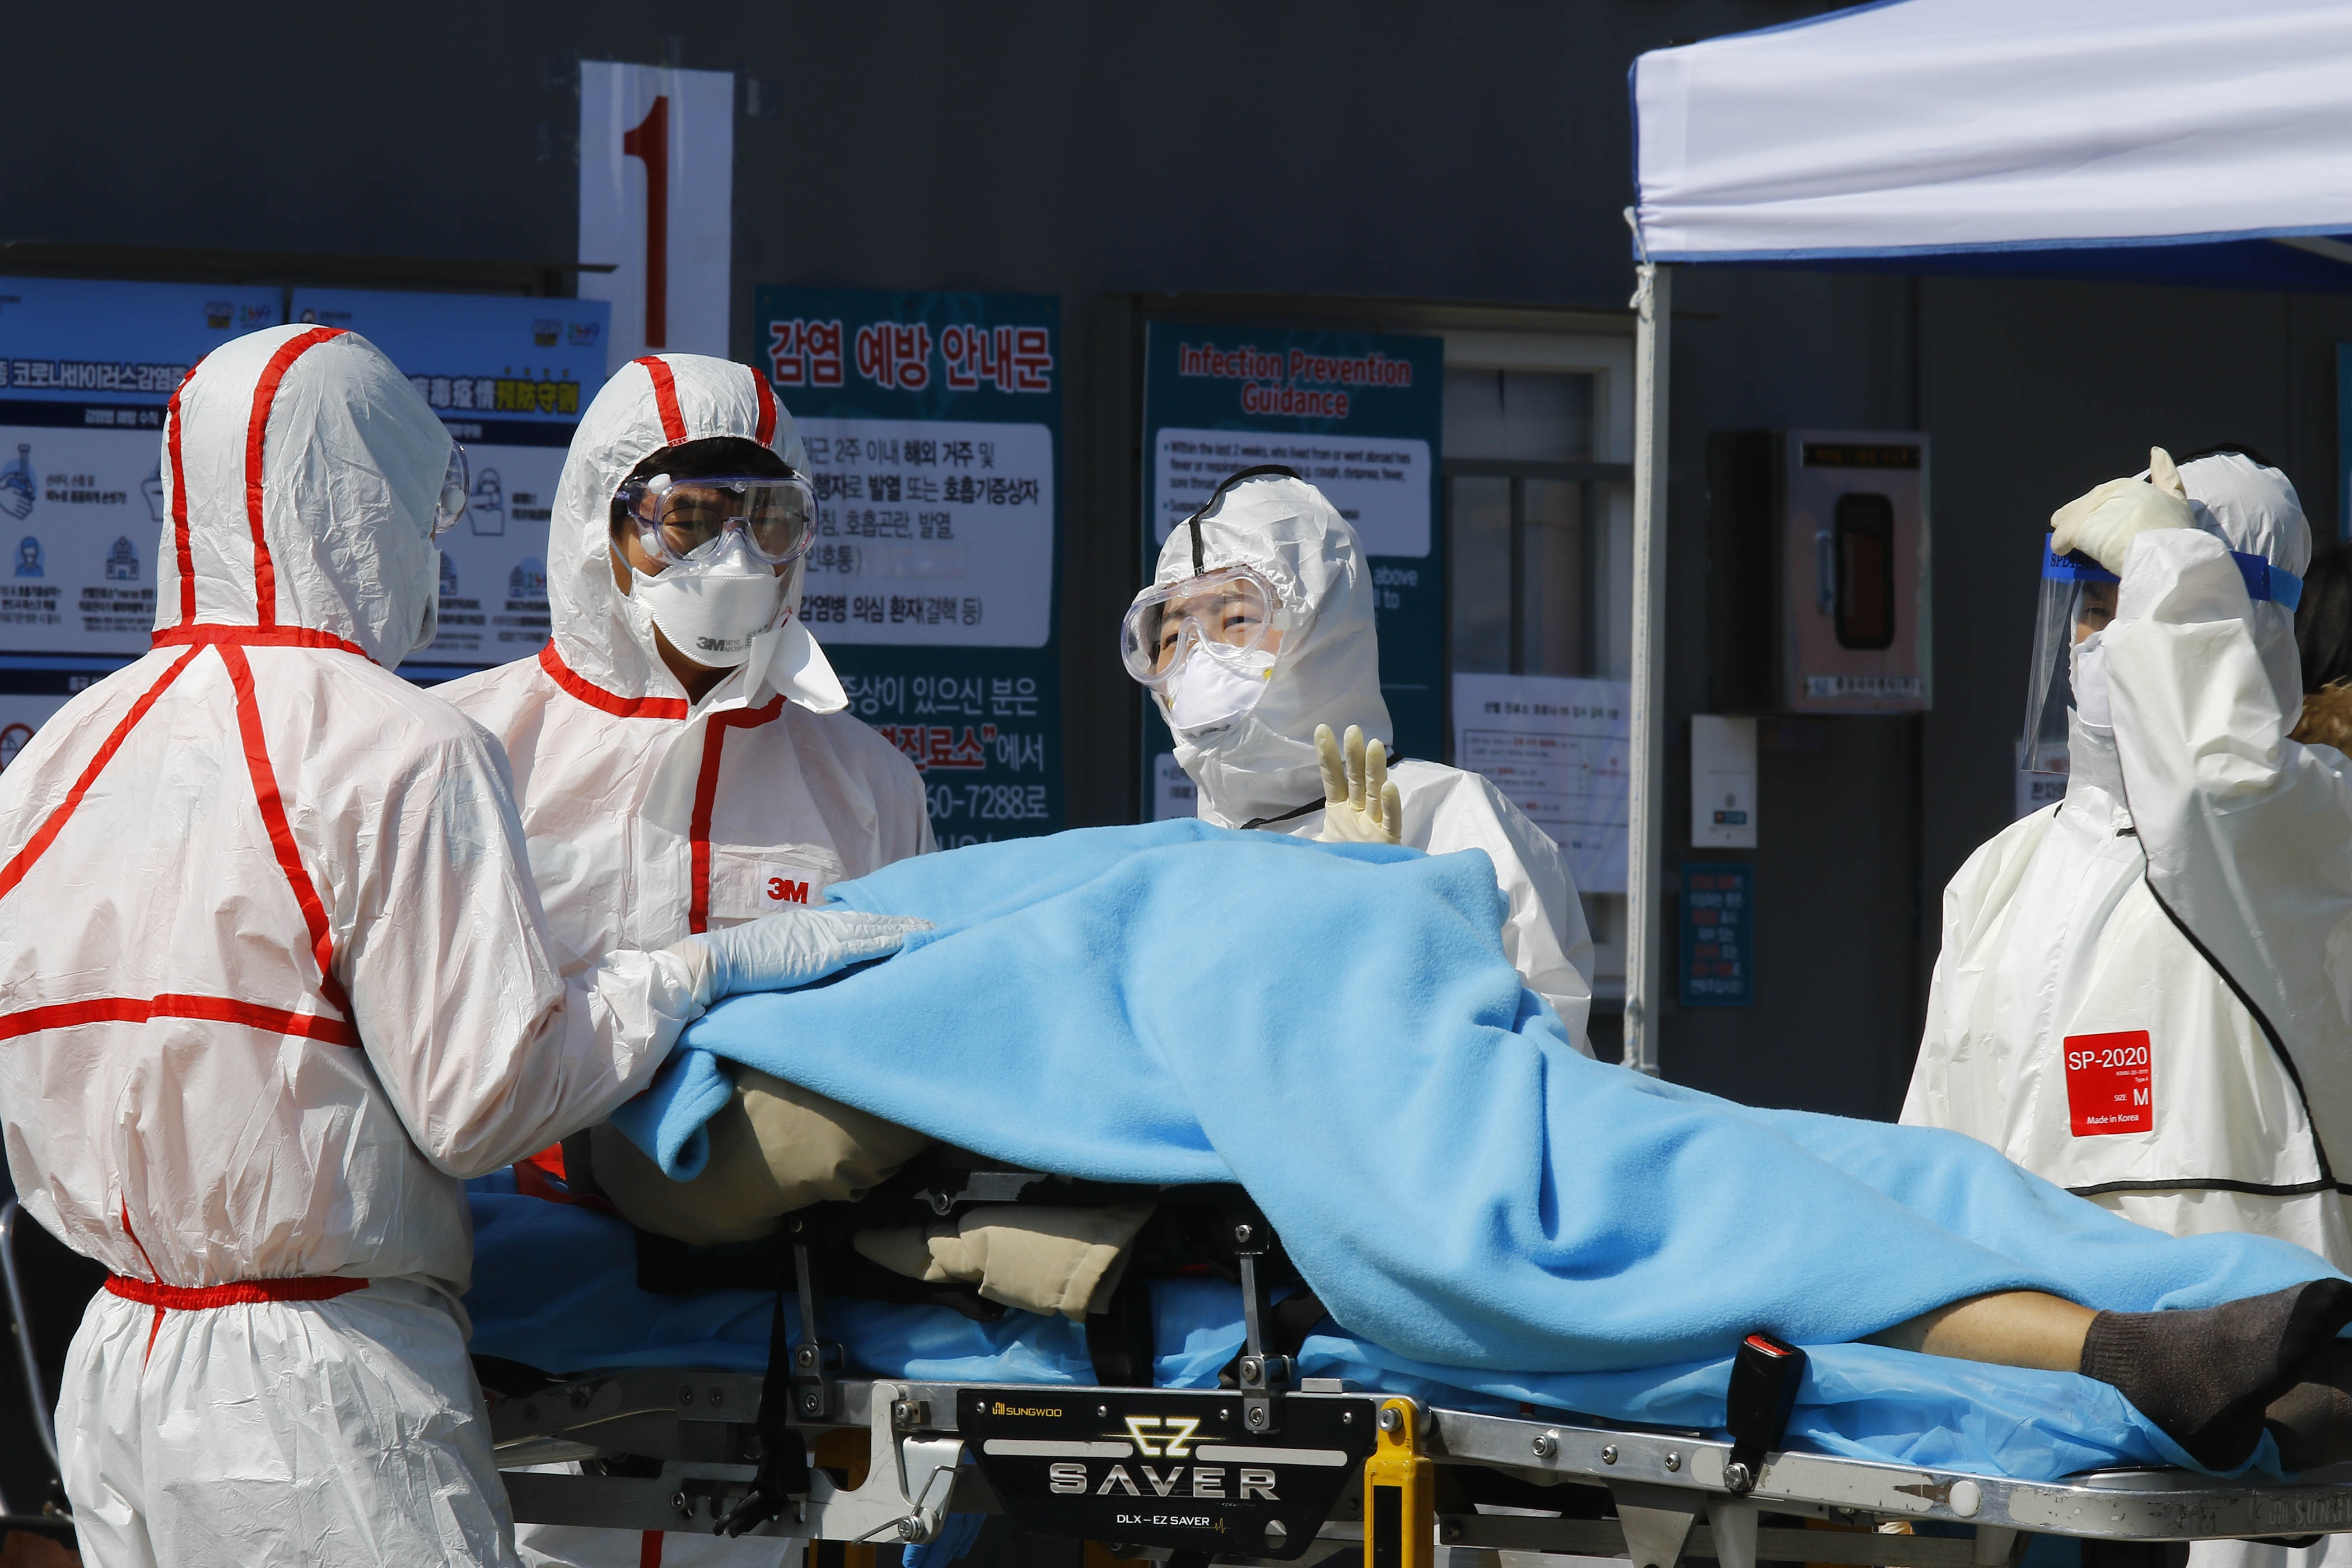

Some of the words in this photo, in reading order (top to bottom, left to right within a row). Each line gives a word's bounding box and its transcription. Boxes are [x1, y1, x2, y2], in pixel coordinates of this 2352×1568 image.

[623, 95, 668, 348] 1
[768, 318, 844, 388] 감염
[856, 321, 932, 391] 예방
[941, 324, 1053, 393] 안내문
[1178, 342, 1284, 379] Infection
[1289, 348, 1412, 386] Prevention
[1241, 380, 1349, 419] Guidance
[835, 437, 862, 465] 2주
[867, 438, 899, 466] 이내
[904, 440, 937, 467] 해외
[942, 442, 974, 468] 거주
[978, 443, 995, 469] 및
[1200, 442, 1213, 455] the
[813, 473, 863, 501] 행자로
[868, 475, 901, 502] 발열
[907, 477, 939, 503] 또는
[942, 478, 1039, 506] 호흡기증상자
[819, 508, 839, 538] 침,
[844, 508, 912, 538] 호흡곤란,
[917, 510, 954, 539] 발열,
[1374, 565, 1418, 586] above
[801, 595, 846, 623] 감염병
[853, 596, 884, 623] 의심
[1383, 591, 1399, 609] to
[696, 636, 726, 651] 3M
[912, 675, 982, 715] 있으신
[992, 678, 1038, 716] 분은
[927, 784, 1049, 820] 60-7288로
[767, 877, 809, 904] 3M
[2068, 1046, 2148, 1071] SP-2020
[2133, 1087, 2149, 1106] M
[2087, 1116, 2108, 1124] Made
[2118, 1113, 2139, 1122] Korea
[1006, 1407, 1062, 1417] SUNGWOO
[1049, 1463, 1280, 1500] SAVER
[1170, 1515, 1210, 1527] SAVER
